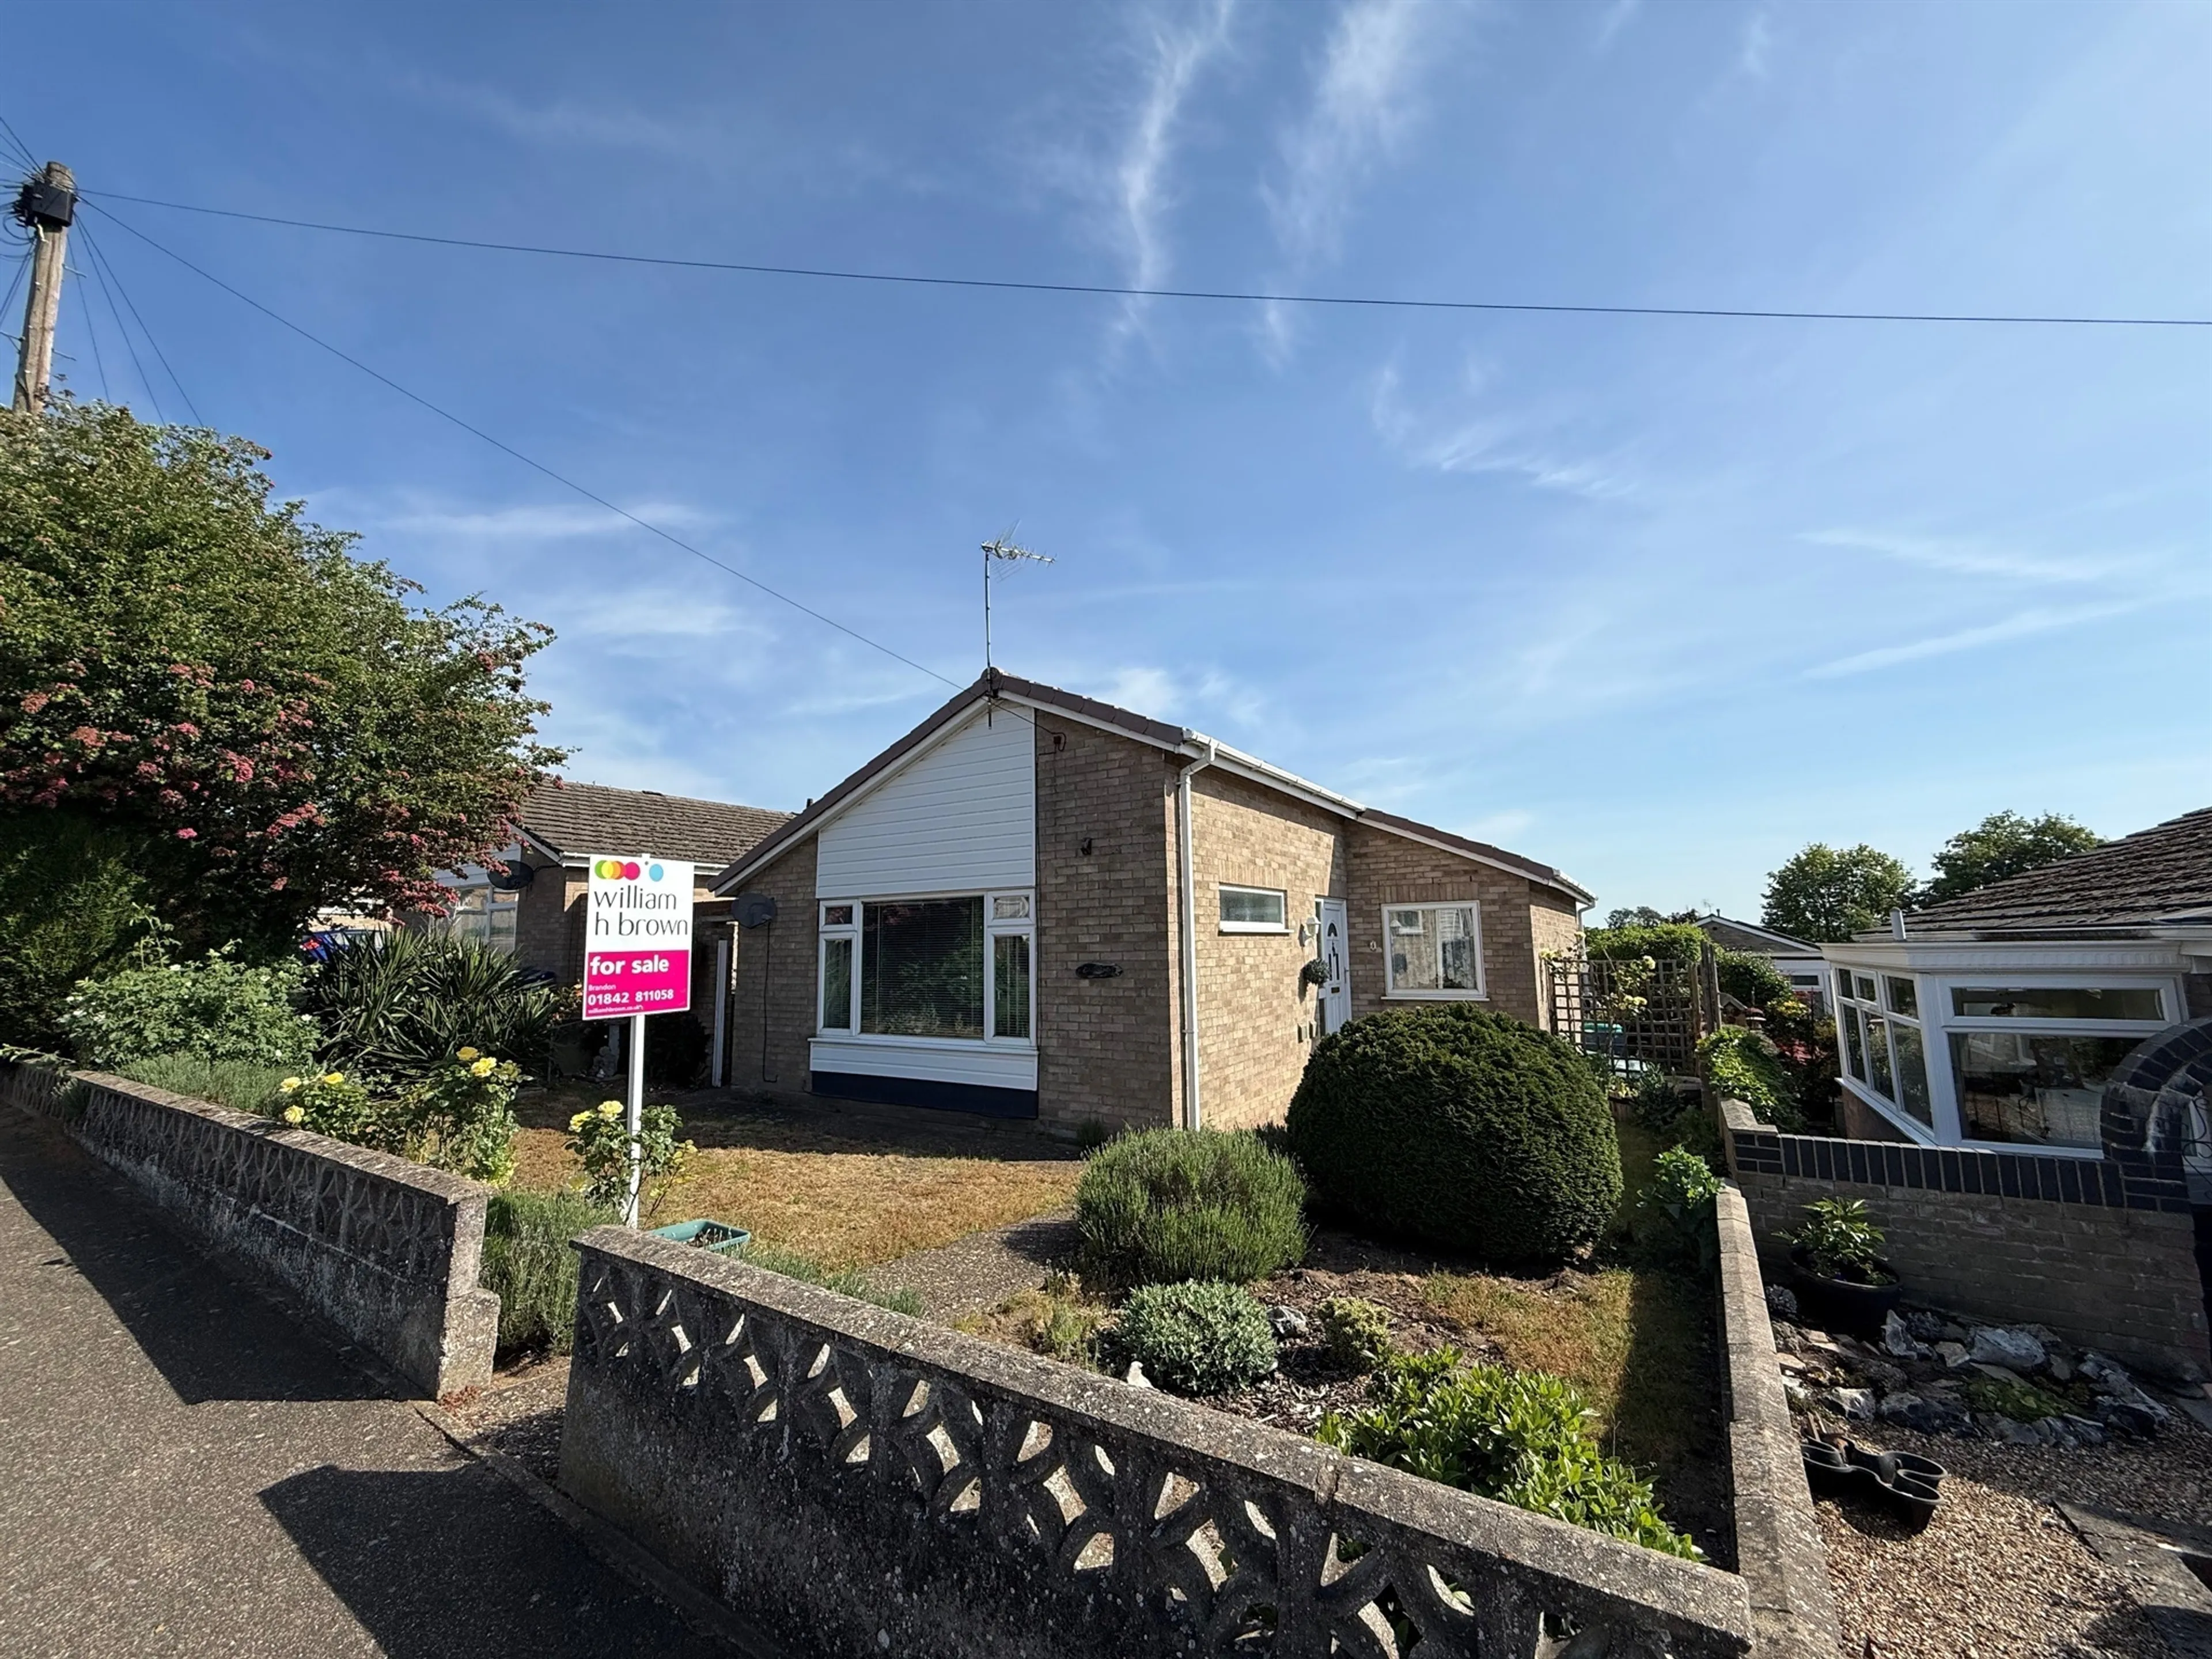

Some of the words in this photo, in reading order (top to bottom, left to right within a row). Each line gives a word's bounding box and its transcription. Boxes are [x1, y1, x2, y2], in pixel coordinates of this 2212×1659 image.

[594, 885, 676, 910] william
[594, 912, 609, 935] h
[619, 912, 688, 935] brown
[590, 956, 626, 975] for
[632, 955, 669, 974] sale
[588, 993, 630, 1005] 01842
[635, 988, 674, 1002] 811058
